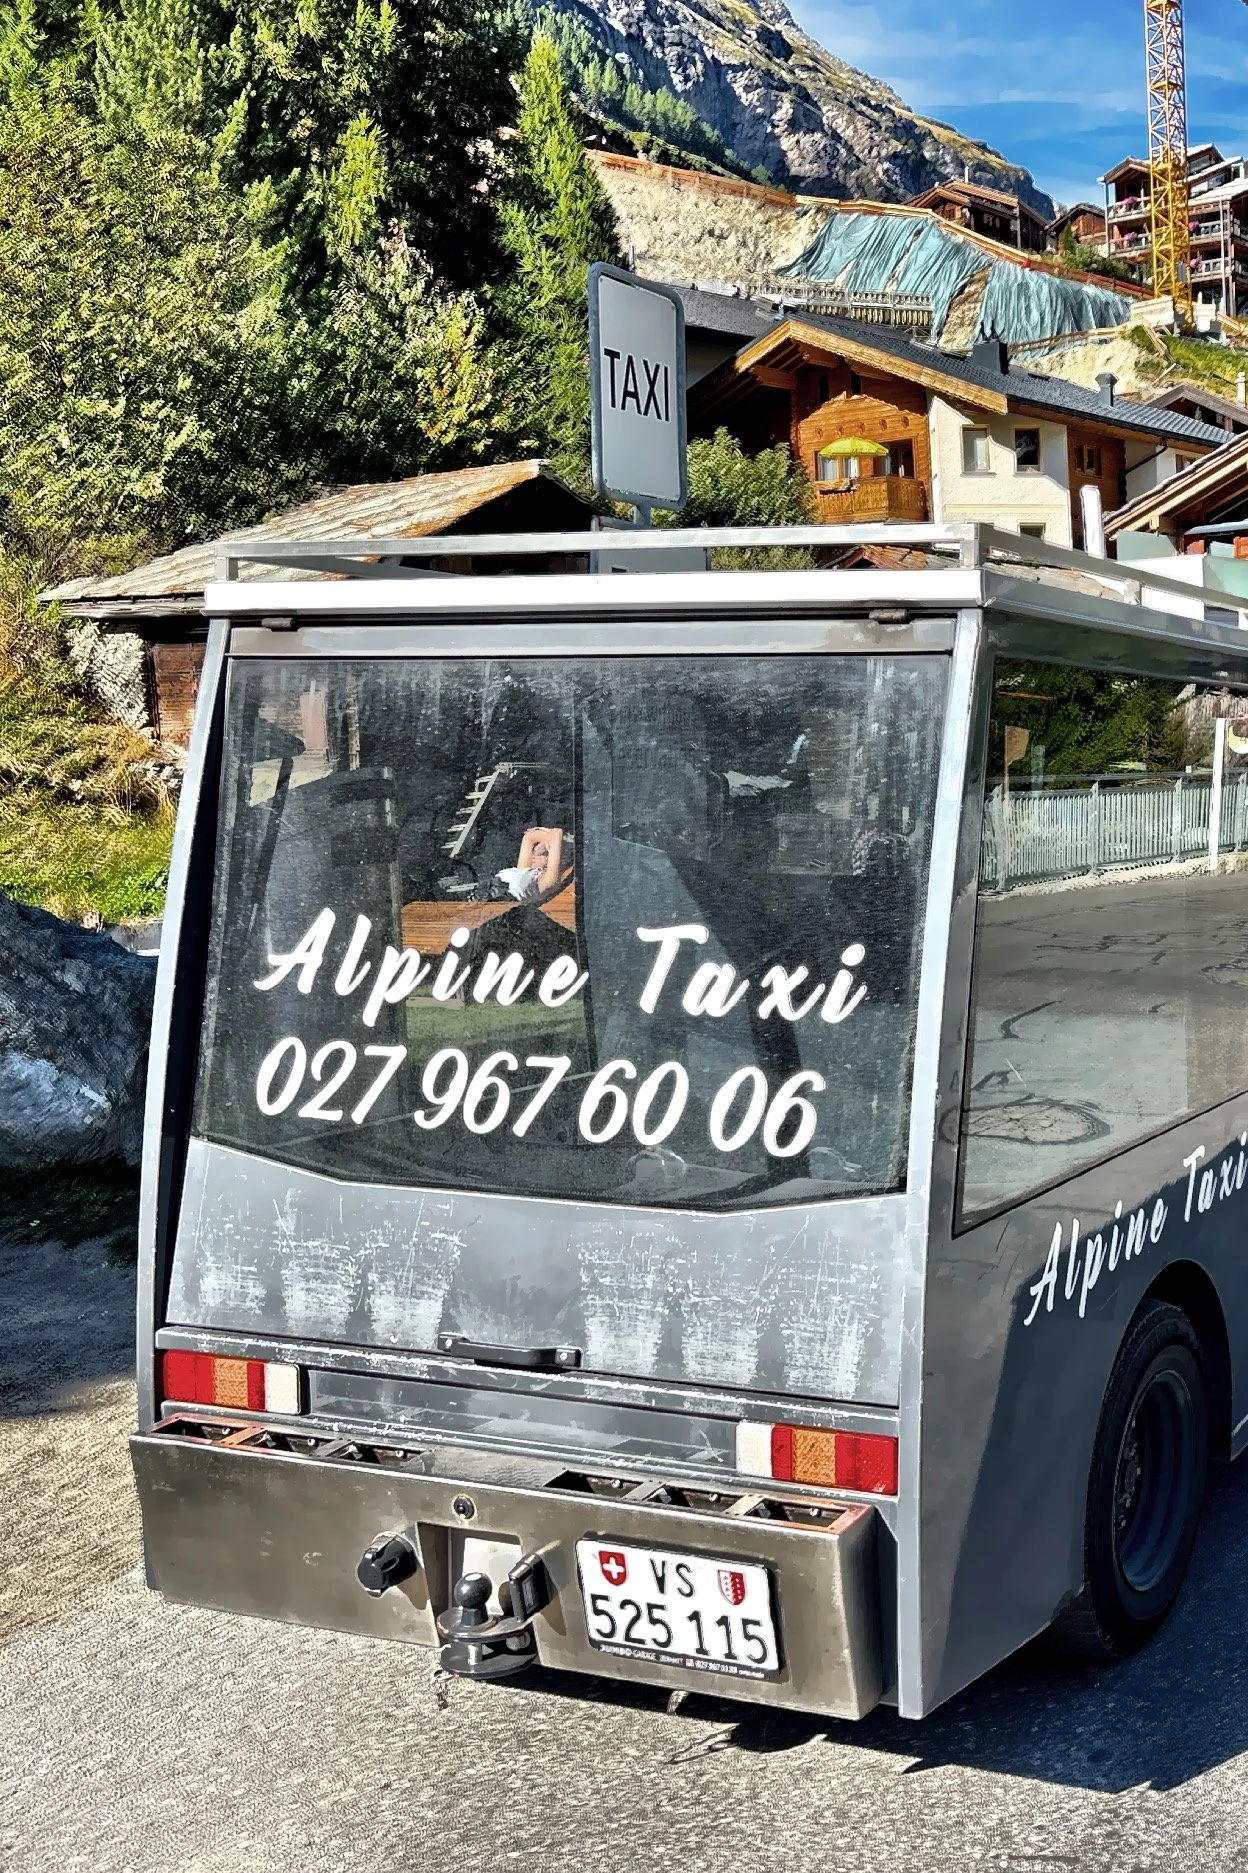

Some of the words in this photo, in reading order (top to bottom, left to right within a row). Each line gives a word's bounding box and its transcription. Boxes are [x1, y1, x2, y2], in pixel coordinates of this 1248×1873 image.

[603, 347, 672, 423] TAXI
[254, 907, 590, 1028] Alpine
[637, 924, 870, 1025] Taxi
[255, 1035, 407, 1126] 027
[413, 1048, 571, 1138] 967
[577, 1059, 690, 1147] 60
[709, 1065, 828, 1159] 06
[1023, 1197, 1169, 1327] Alpine
[1182, 1130, 1248, 1223] Taxi
[649, 1558, 695, 1598] VS
[590, 1593, 673, 1649] 525
[686, 1609, 769, 1665] 115
